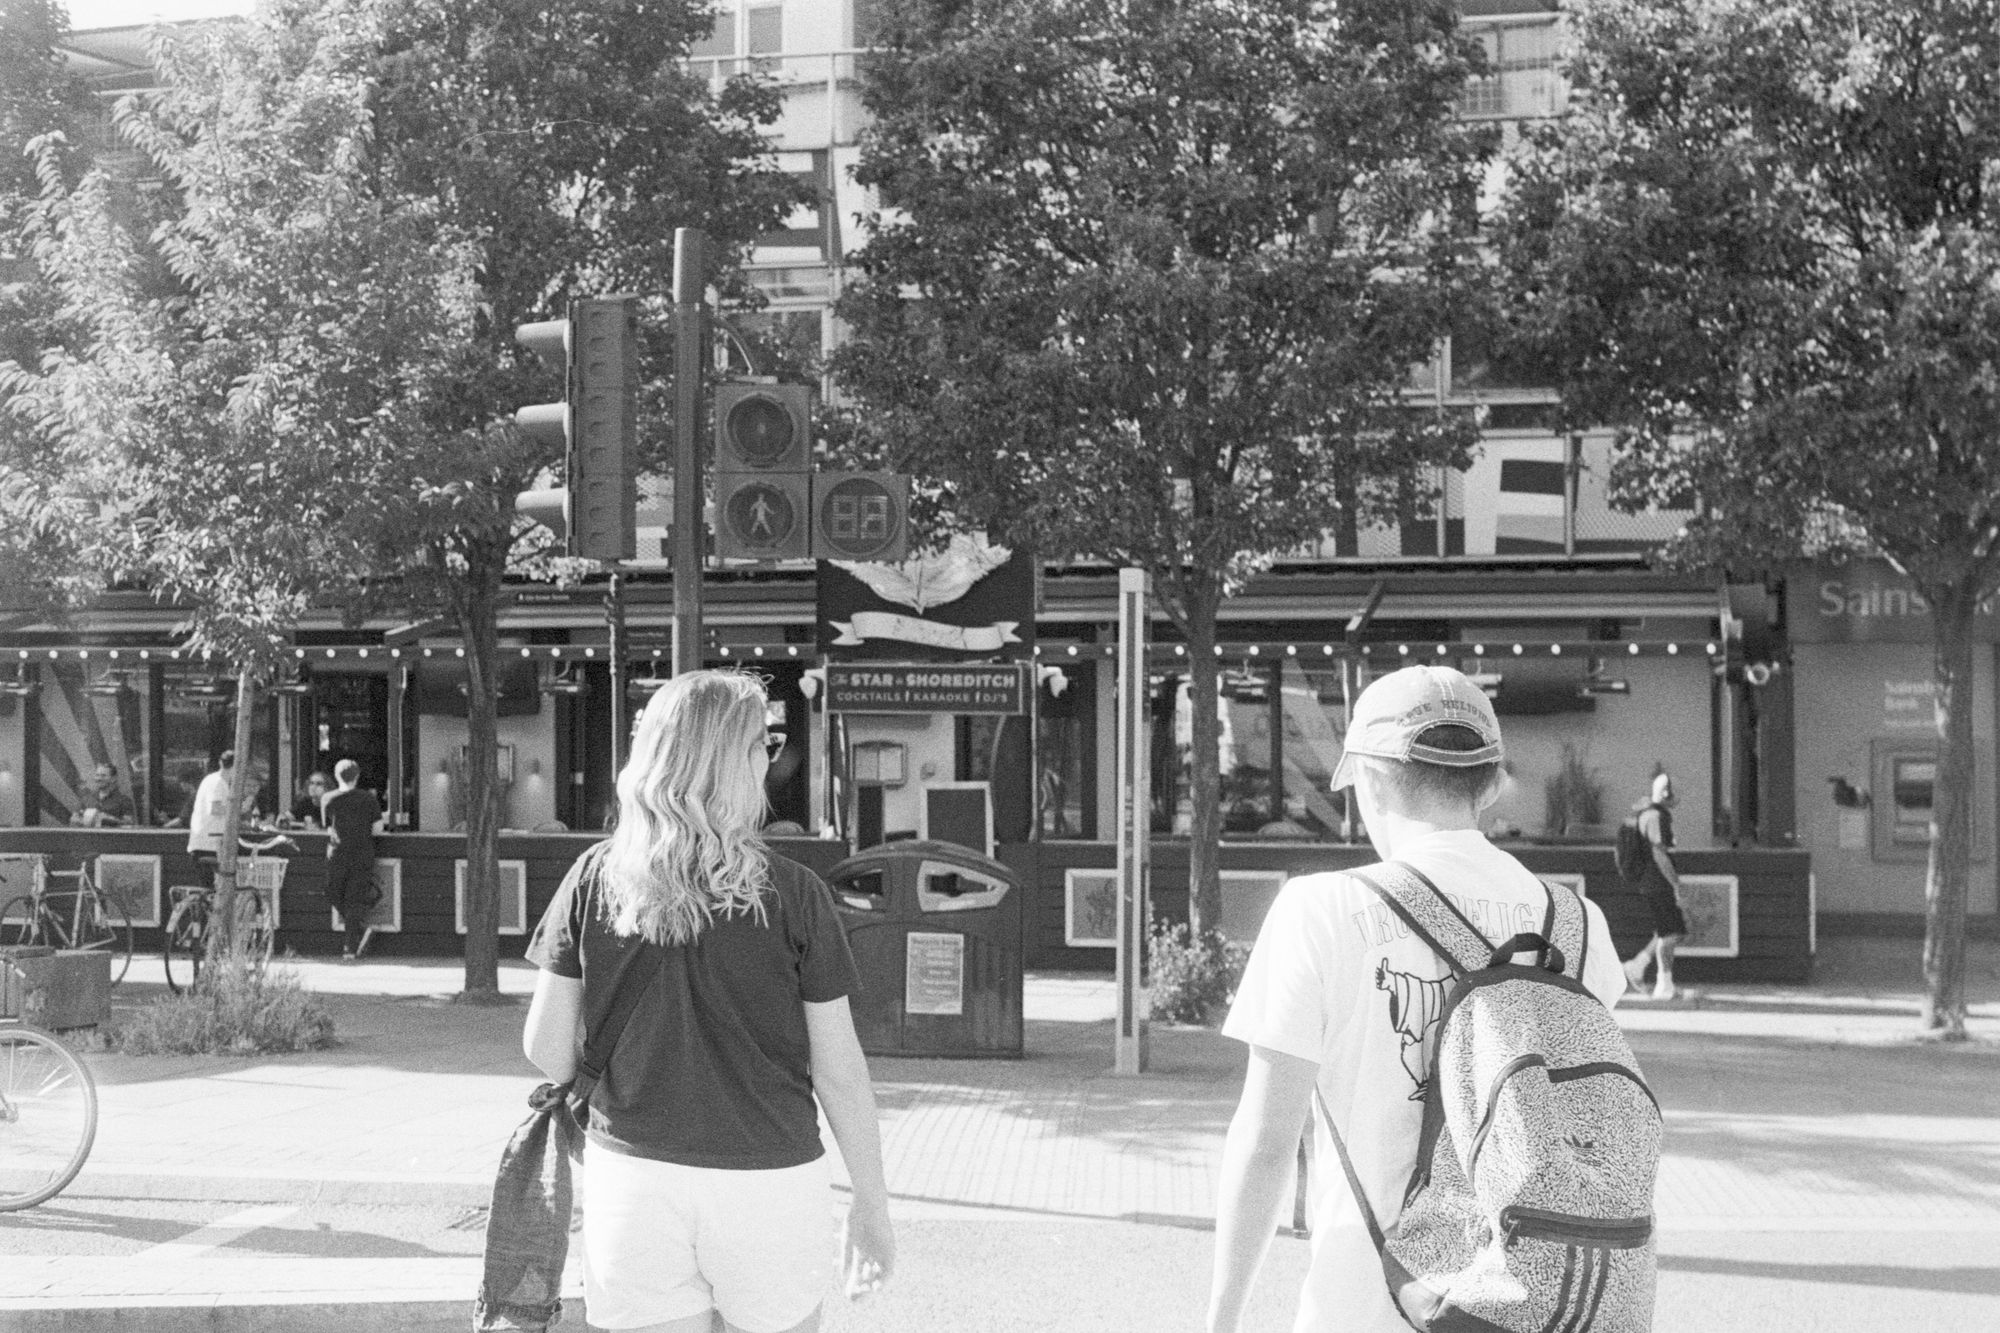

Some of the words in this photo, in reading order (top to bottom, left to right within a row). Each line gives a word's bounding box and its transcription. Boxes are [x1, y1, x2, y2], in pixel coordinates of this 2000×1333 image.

[1819, 580, 1930, 617] Sains
[850, 672, 893, 687] STAR
[906, 672, 1015, 688] SHOREDITCH
[836, 691, 901, 702] COCKTAILS
[913, 691, 970, 702] KARAOKE
[1351, 901, 1411, 953] TRU
